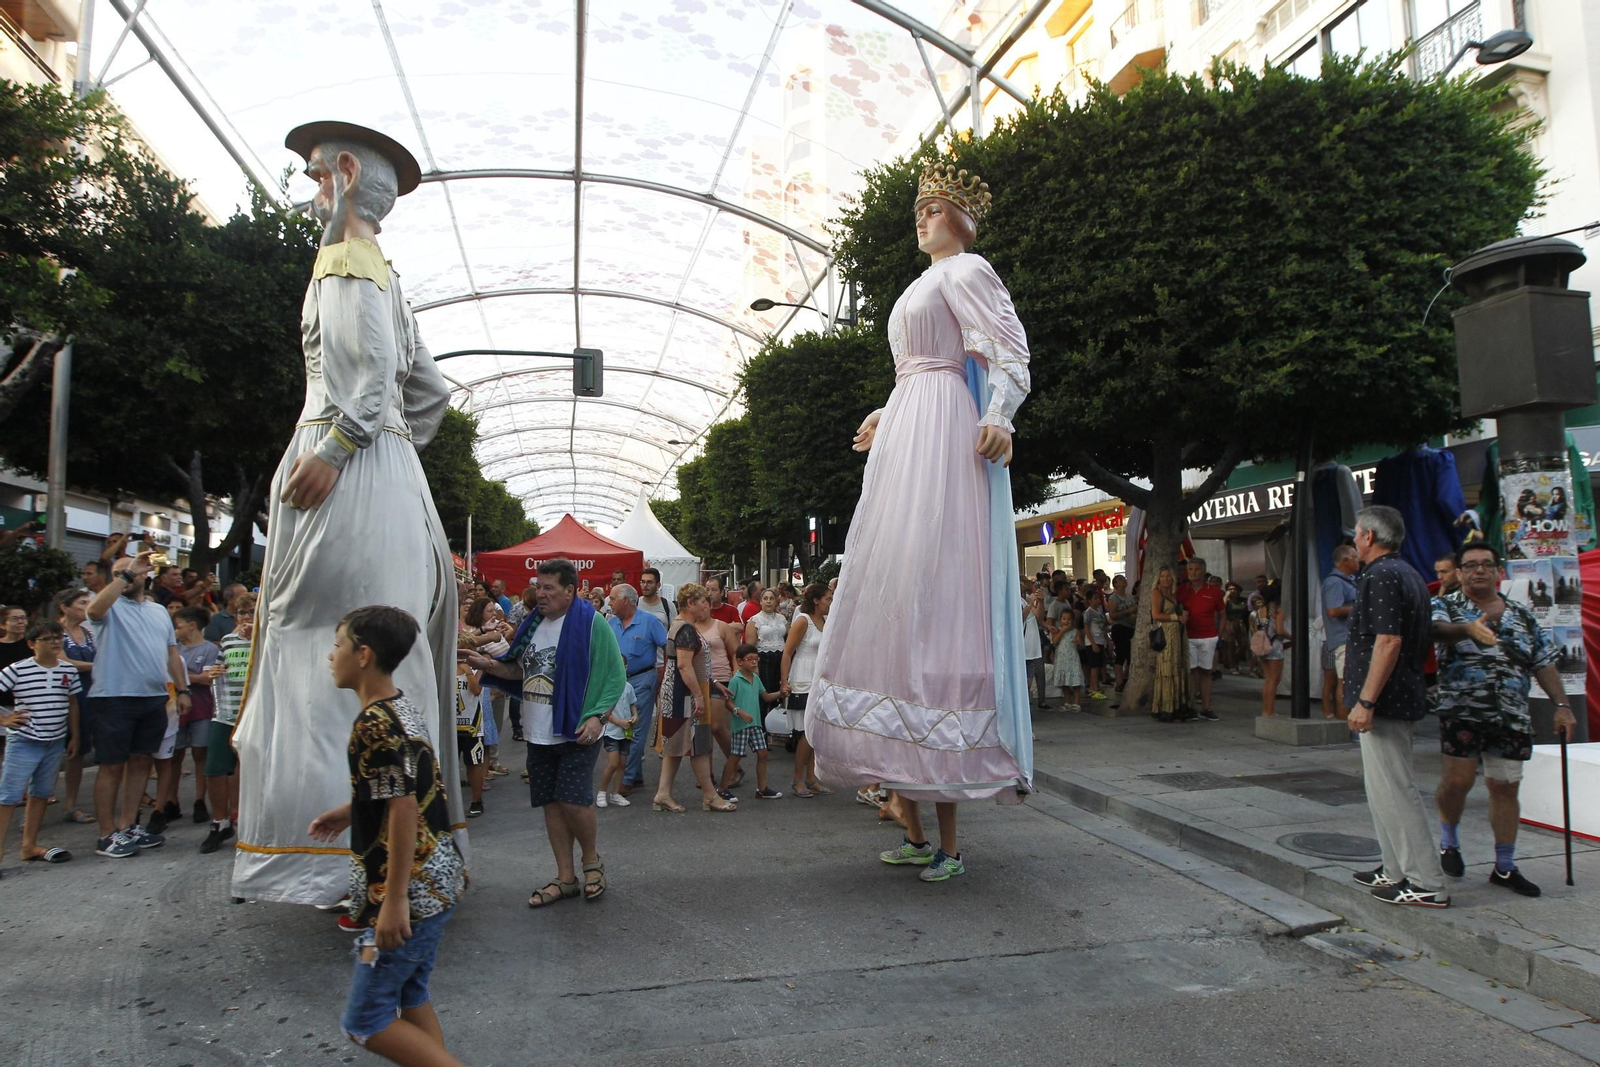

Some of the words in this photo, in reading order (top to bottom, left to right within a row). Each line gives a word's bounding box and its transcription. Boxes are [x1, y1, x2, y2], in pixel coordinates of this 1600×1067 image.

[1056, 505, 1124, 540] Soloptical
[1186, 491, 1261, 524] OYERIA
[525, 557, 593, 571] Crmpo
